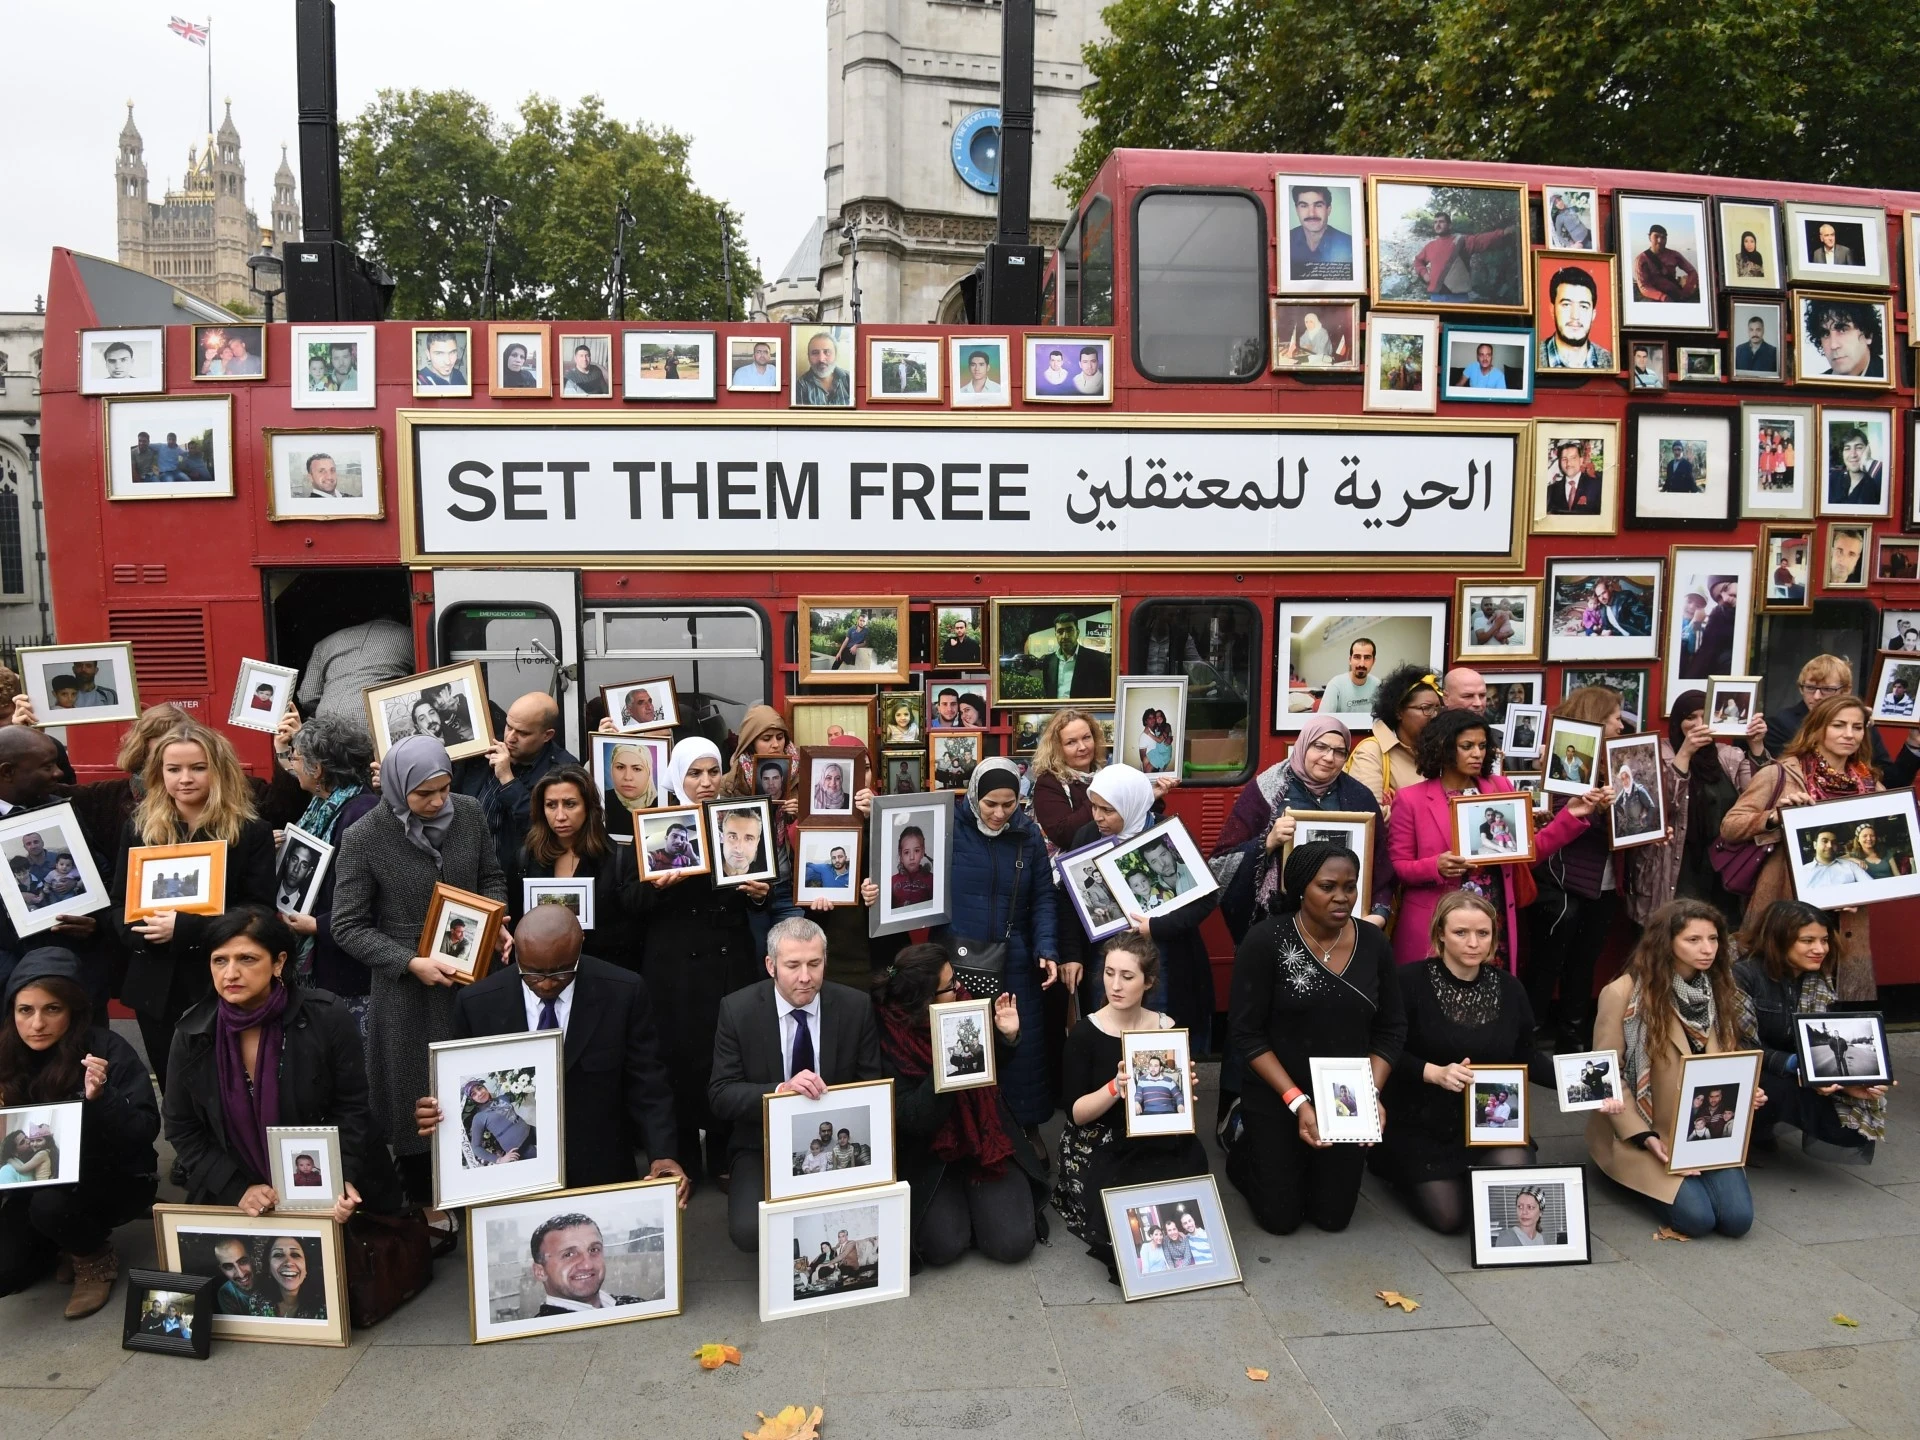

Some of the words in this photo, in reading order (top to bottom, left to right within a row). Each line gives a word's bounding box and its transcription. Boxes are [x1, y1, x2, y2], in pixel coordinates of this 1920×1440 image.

[958, 126, 968, 138] THE
[964, 112, 985, 126] PEOPLE
[448, 461, 589, 521] SET
[613, 461, 819, 520] THEM
[851, 461, 1031, 521] FREE
[1066, 455, 1309, 532] للمعتقلين
[1335, 455, 1492, 529] الحرية
